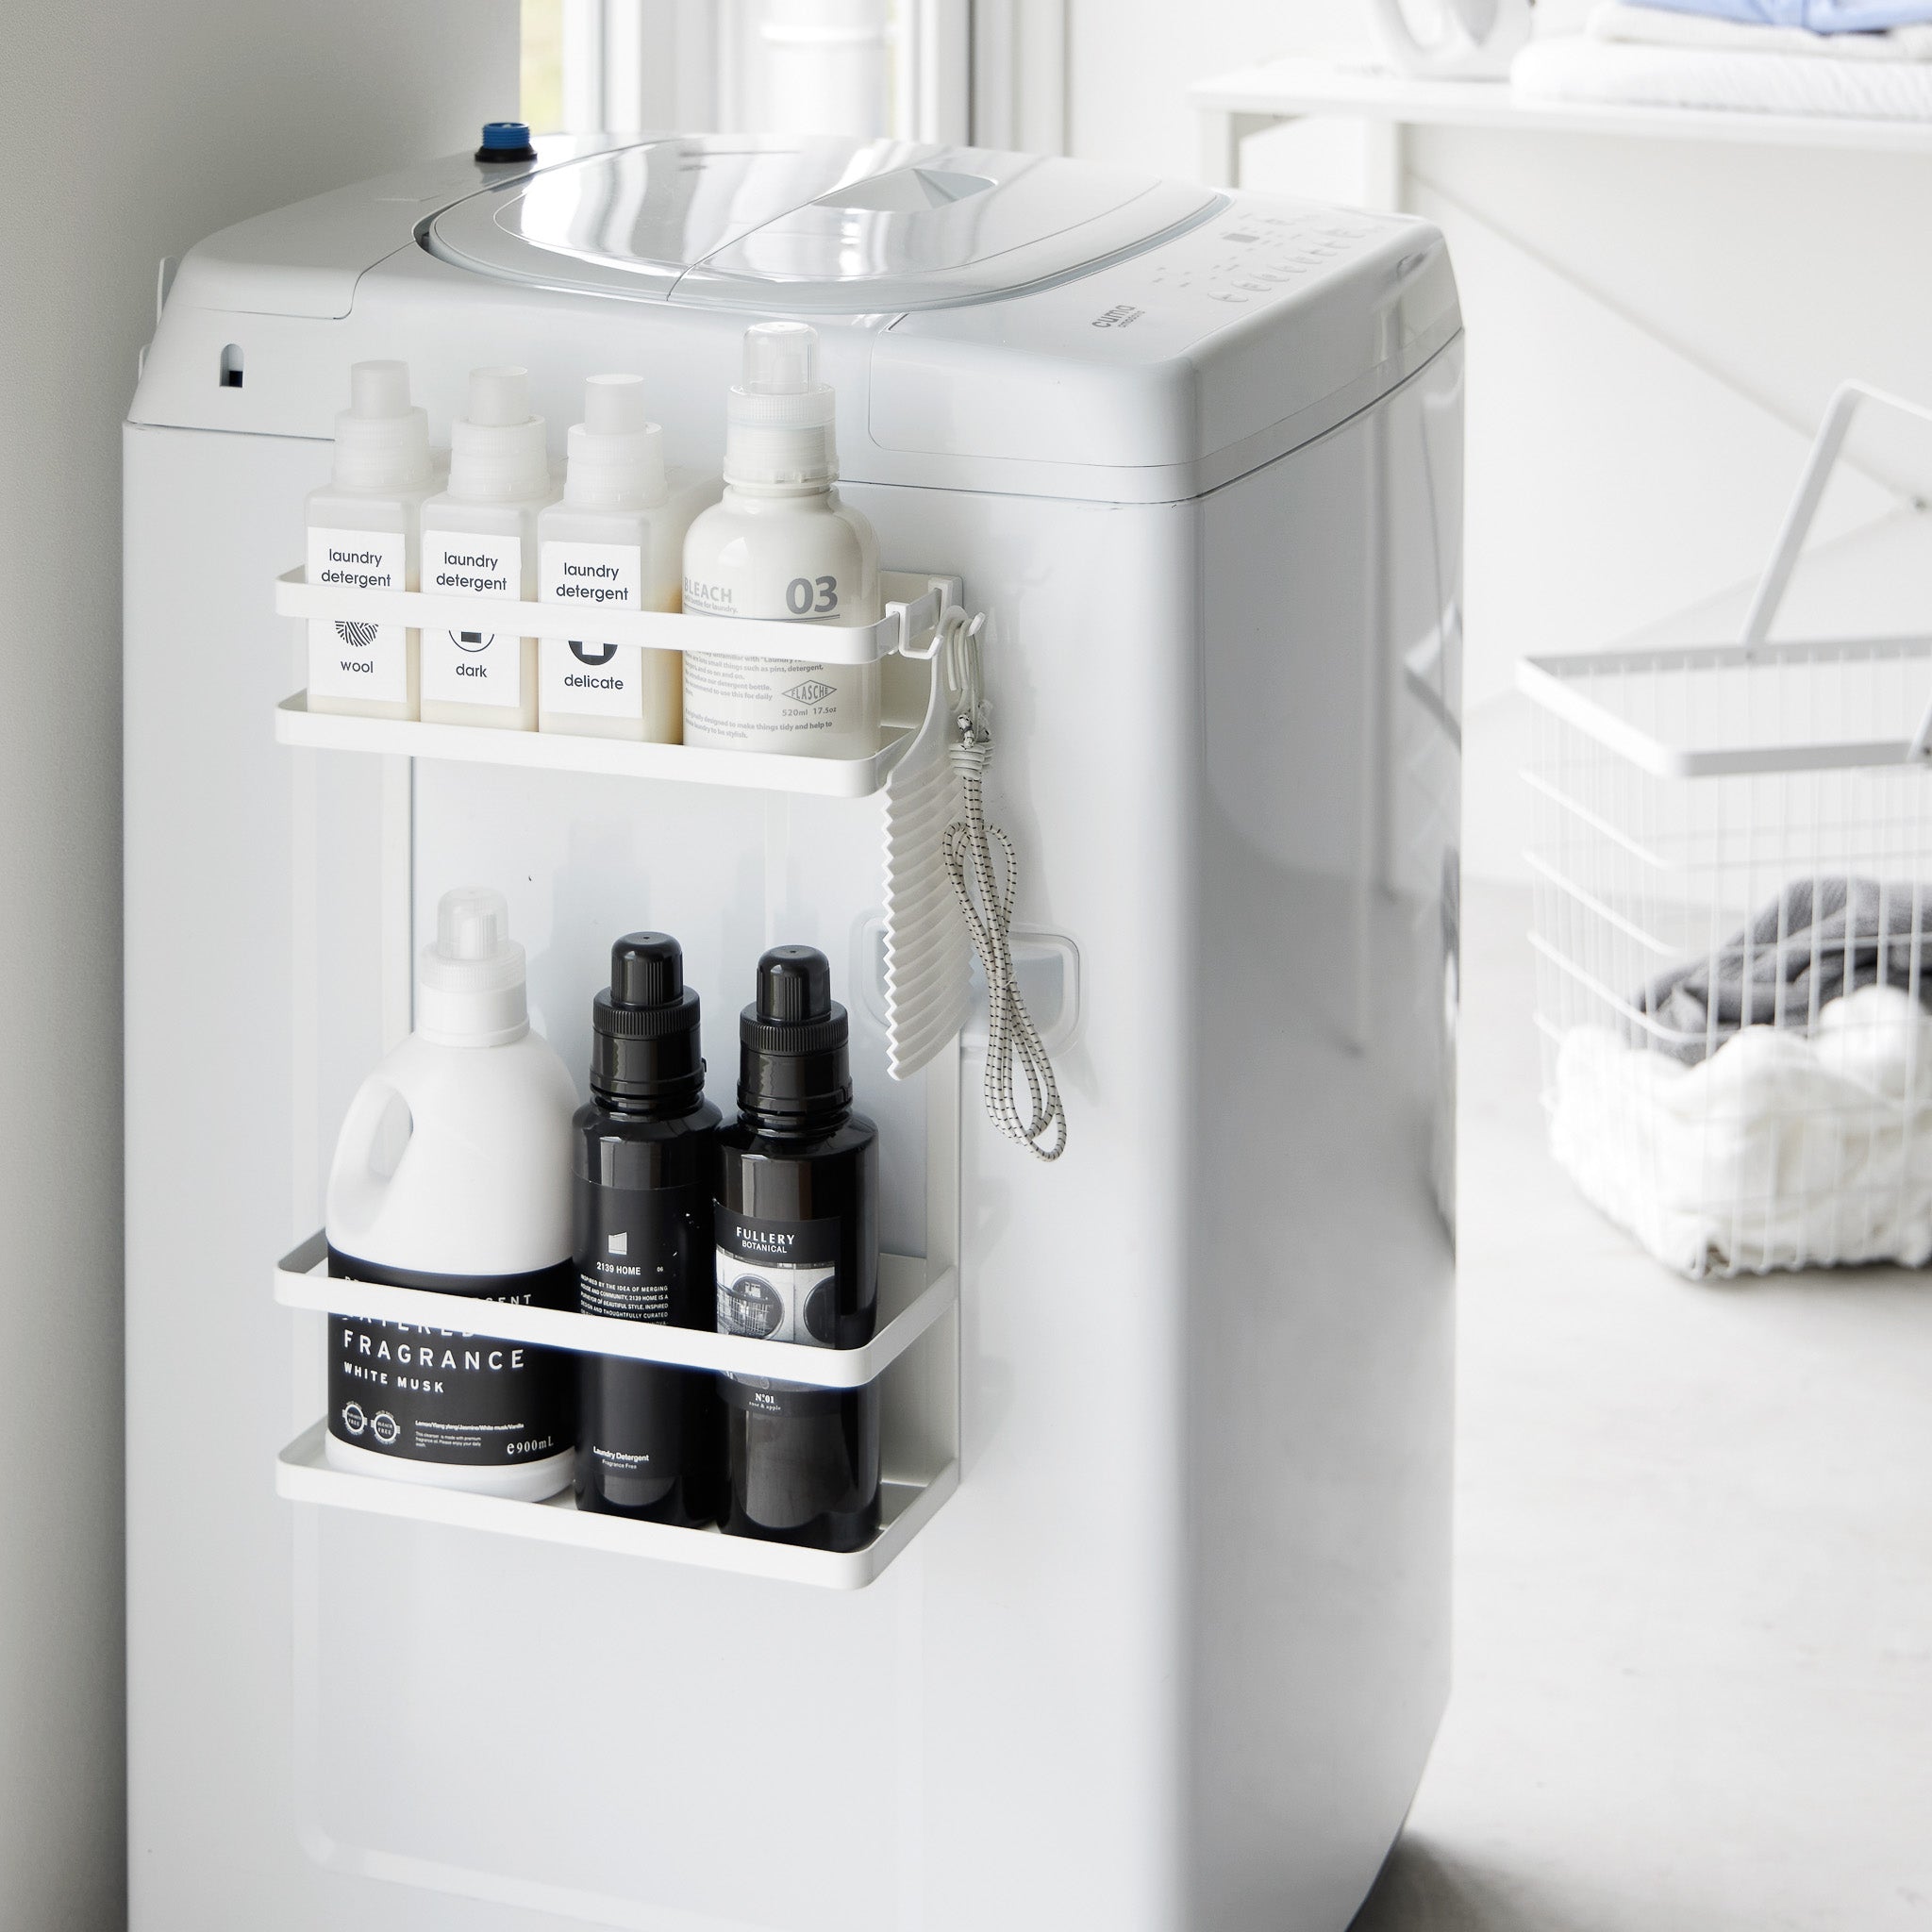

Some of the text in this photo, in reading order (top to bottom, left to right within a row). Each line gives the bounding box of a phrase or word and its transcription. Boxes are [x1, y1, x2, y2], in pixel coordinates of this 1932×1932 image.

[1091, 305, 1136, 329] cuma
[328, 548, 383, 568] laundry
[443, 551, 499, 572] laundry
[321, 570, 391, 589] detergent
[563, 562, 620, 582] laundry
[436, 573, 508, 592] detergent
[684, 576, 732, 604] BLEACH
[556, 584, 628, 603] detergent
[785, 575, 839, 615] 03
[341, 660, 374, 675] wool
[456, 663, 488, 679] dark
[724, 662, 743, 672] things
[564, 674, 625, 691] delicate
[717, 679, 748, 690] detergent
[755, 693, 773, 702] daily
[791, 685, 829, 700] FLASCHE
[782, 708, 808, 717] 520ml
[737, 722, 756, 730] make
[756, 723, 778, 732] things
[779, 723, 793, 732] tidy
[794, 721, 808, 730] and
[809, 720, 824, 729] help
[736, 1226, 795, 1245] FULLERY
[741, 1240, 788, 1254] BOTANICAL
[596, 1261, 641, 1275] 2139 HOME
[606, 1282, 616, 1291] THE
[604, 1308, 642, 1319] THOUGHTFULLY
[343, 1329, 525, 1371] FRAGRANCE
[343, 1361, 444, 1394] WHITE MUSK
[593, 1446, 649, 1462] Laundry Detergent
[602, 1458, 625, 1469] Fragrance
